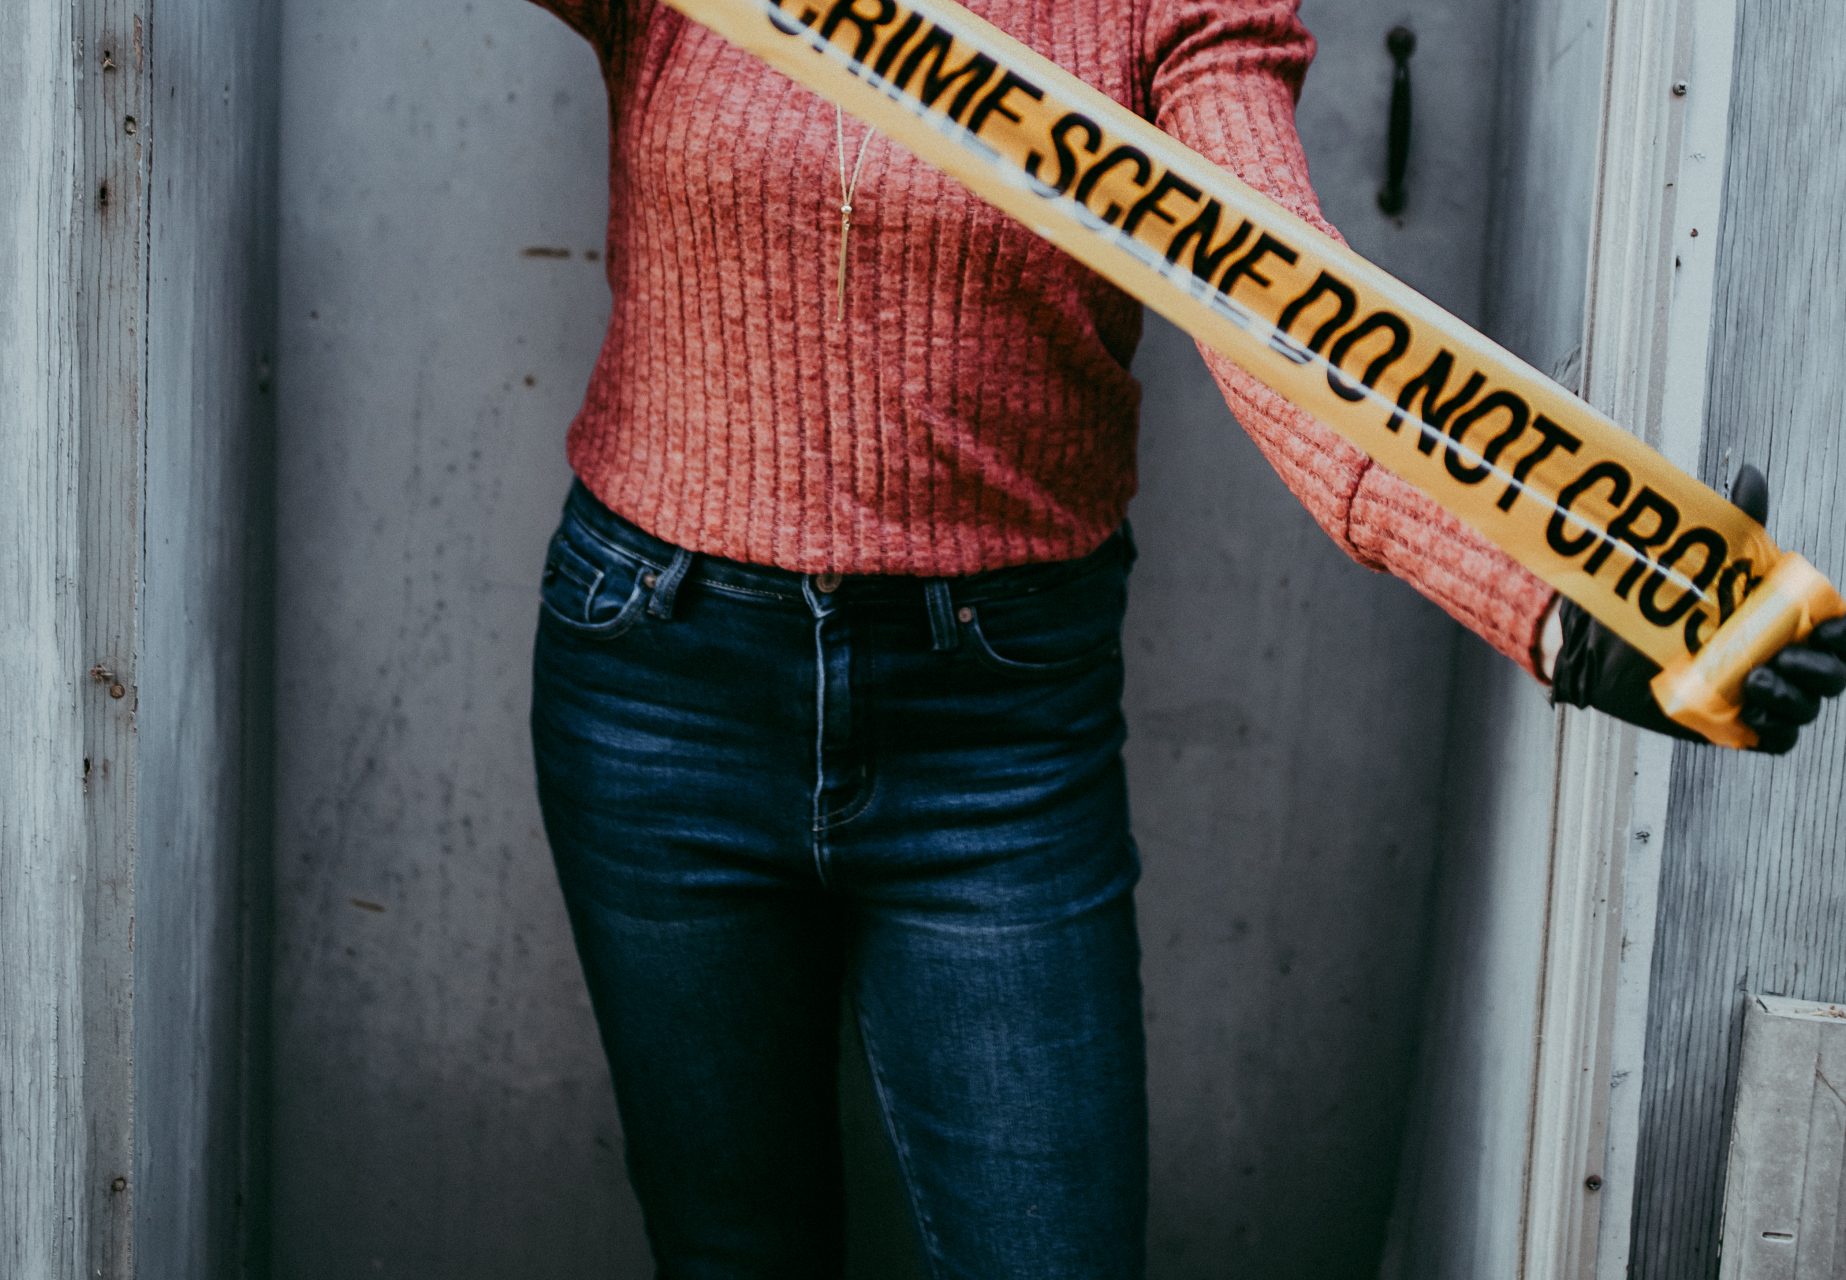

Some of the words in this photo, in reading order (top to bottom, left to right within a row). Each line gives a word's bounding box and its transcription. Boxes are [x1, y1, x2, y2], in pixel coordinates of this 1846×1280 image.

[1025, 112, 1299, 324] SCENE
[1268, 270, 1412, 403] DO
[1386, 349, 1583, 513] NOT
